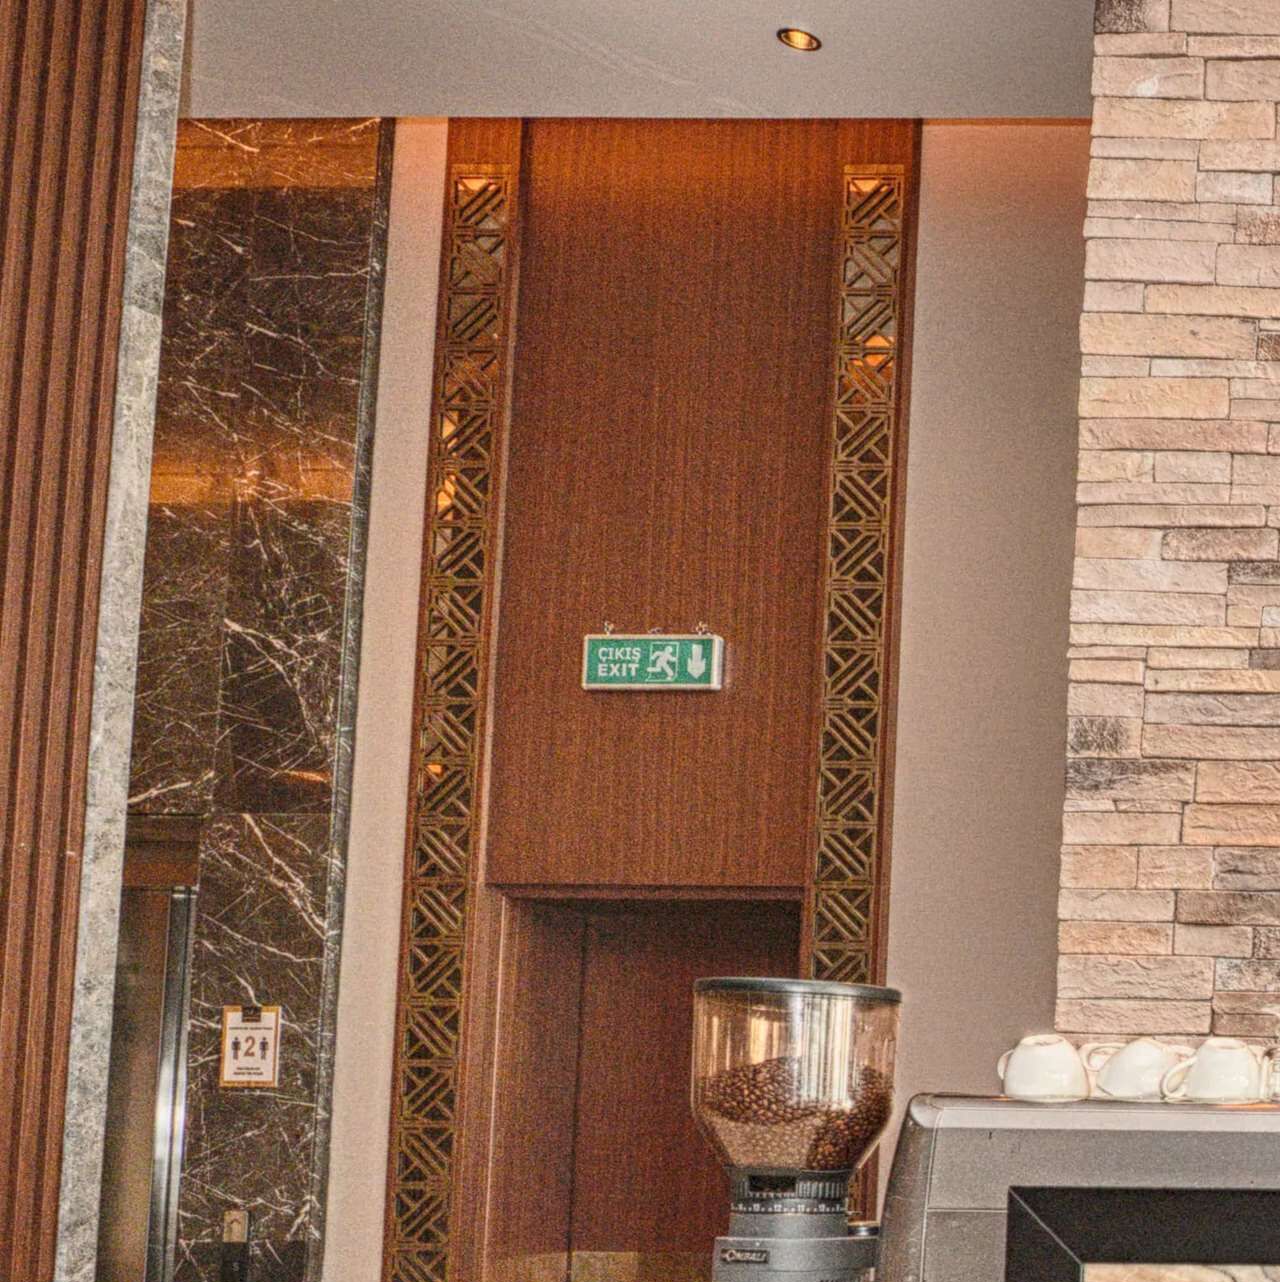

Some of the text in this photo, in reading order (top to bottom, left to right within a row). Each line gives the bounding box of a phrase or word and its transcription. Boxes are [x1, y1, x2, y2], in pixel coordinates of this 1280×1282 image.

[598, 647, 641, 663] ÇIKIŞ
[598, 663, 639, 676] EXIT
[243, 1035, 256, 1057] 2
